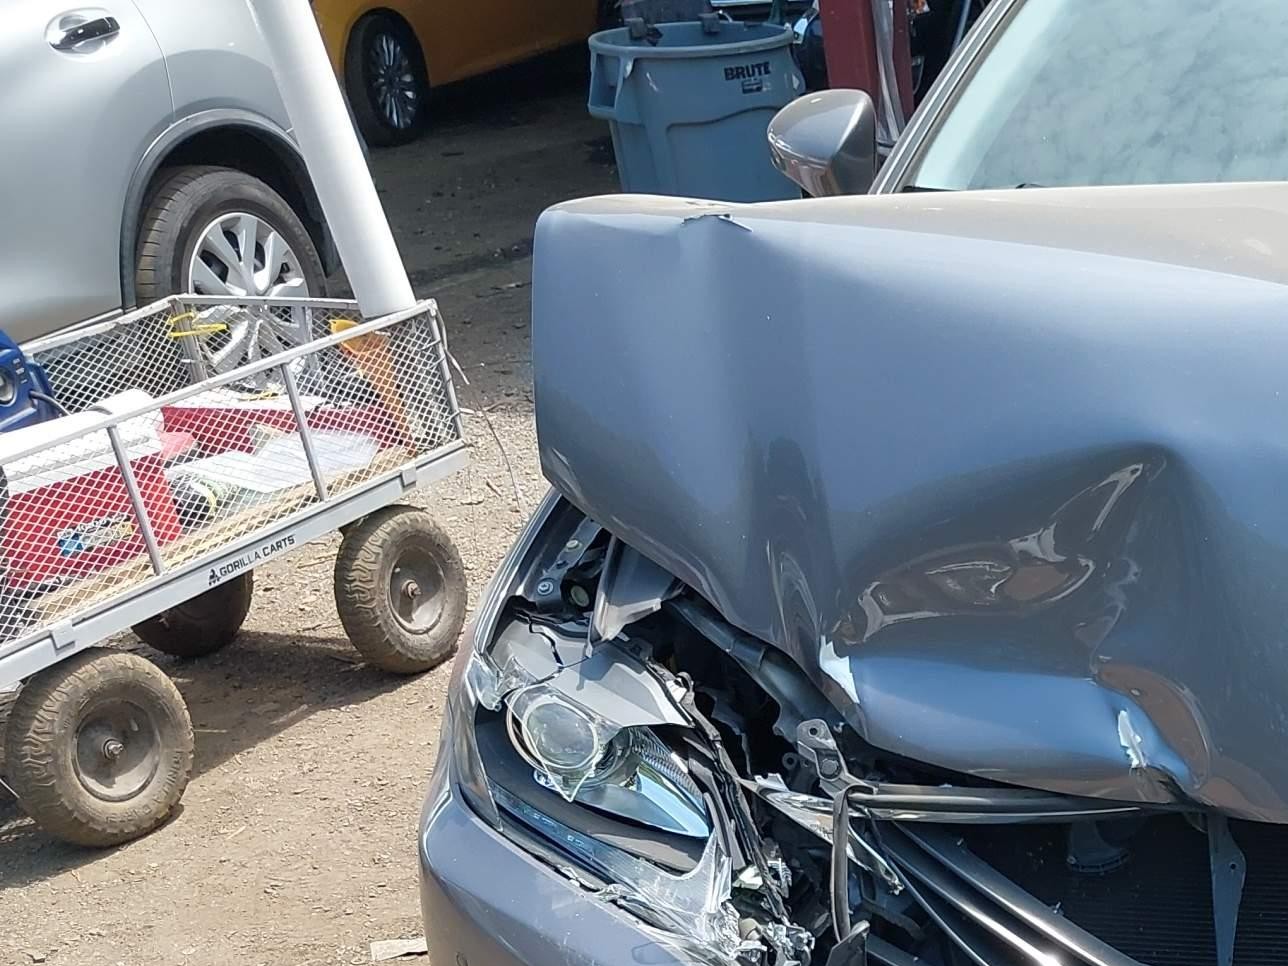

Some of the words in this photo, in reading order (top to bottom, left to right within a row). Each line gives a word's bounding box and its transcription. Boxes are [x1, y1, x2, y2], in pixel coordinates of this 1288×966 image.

[724, 61, 771, 80] BRUTE
[219, 551, 262, 577] GORILLA
[262, 535, 295, 557] CARTS
